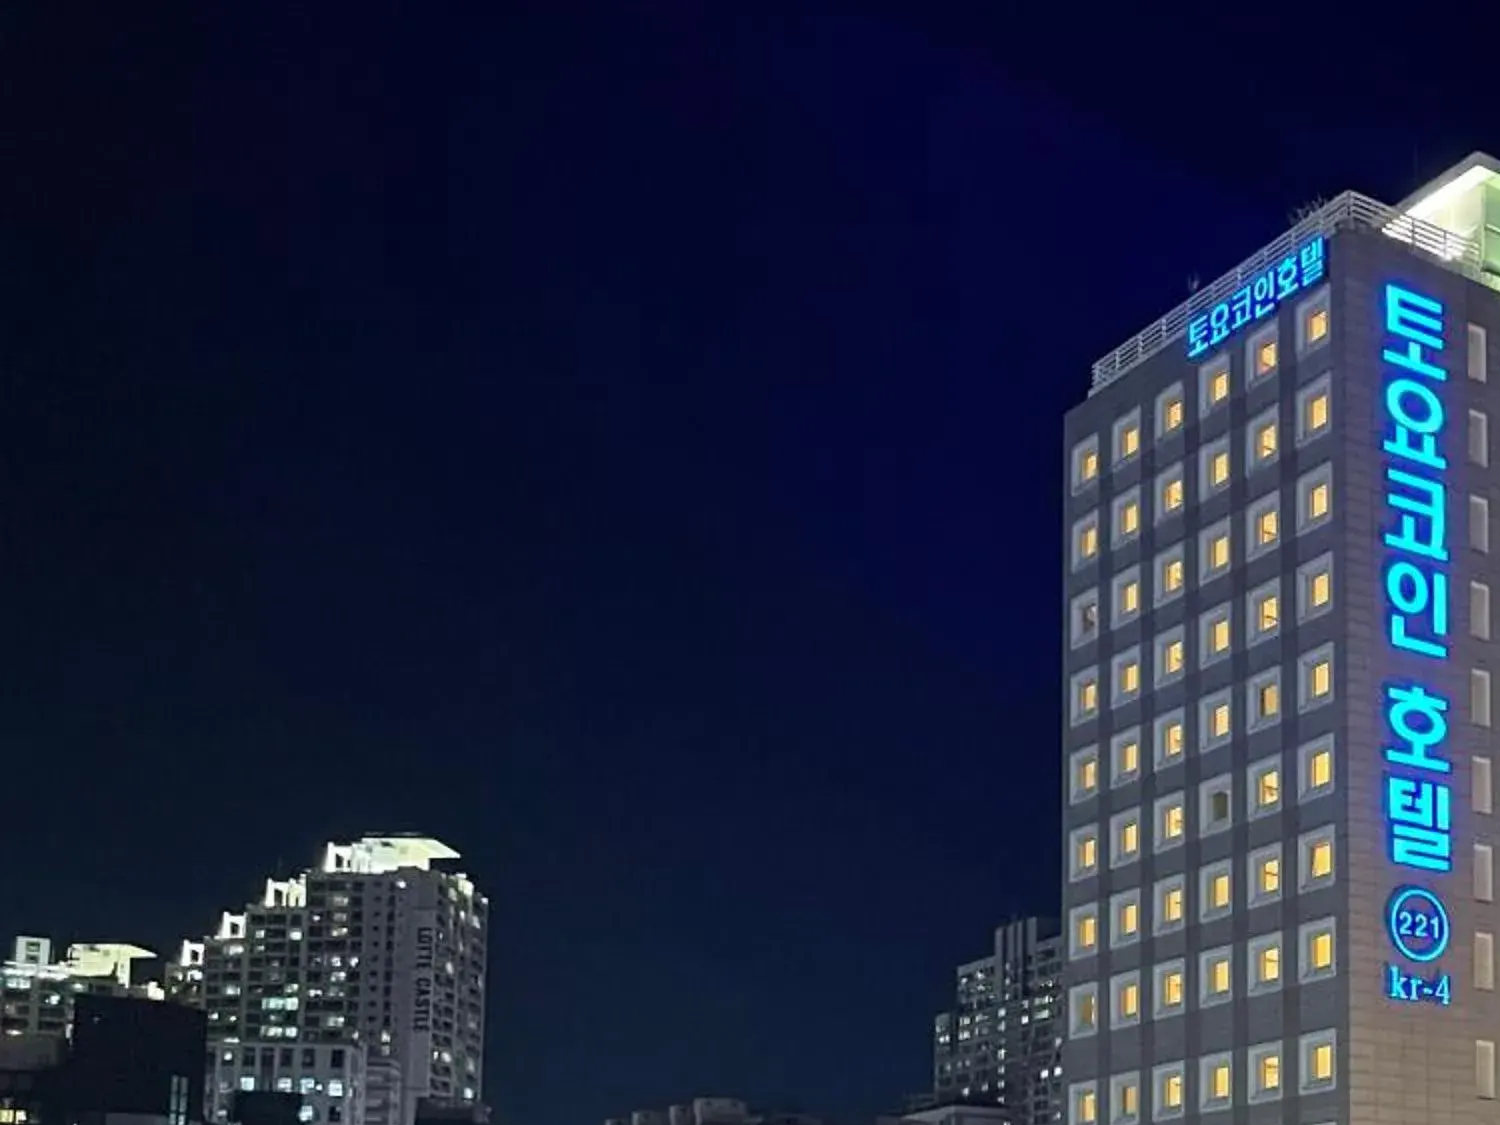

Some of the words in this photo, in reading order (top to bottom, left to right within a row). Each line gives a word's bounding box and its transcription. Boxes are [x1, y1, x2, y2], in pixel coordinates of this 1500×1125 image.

[1187, 236, 1323, 358] 토요코인호텔
[1383, 283, 1448, 658] 토요코인
[1386, 687, 1451, 872] 호텔
[416, 926, 433, 968] LOTTE
[1399, 911, 1441, 940] 221
[412, 977, 431, 1033] CASTLE
[1391, 972, 1451, 1005] kr-4
